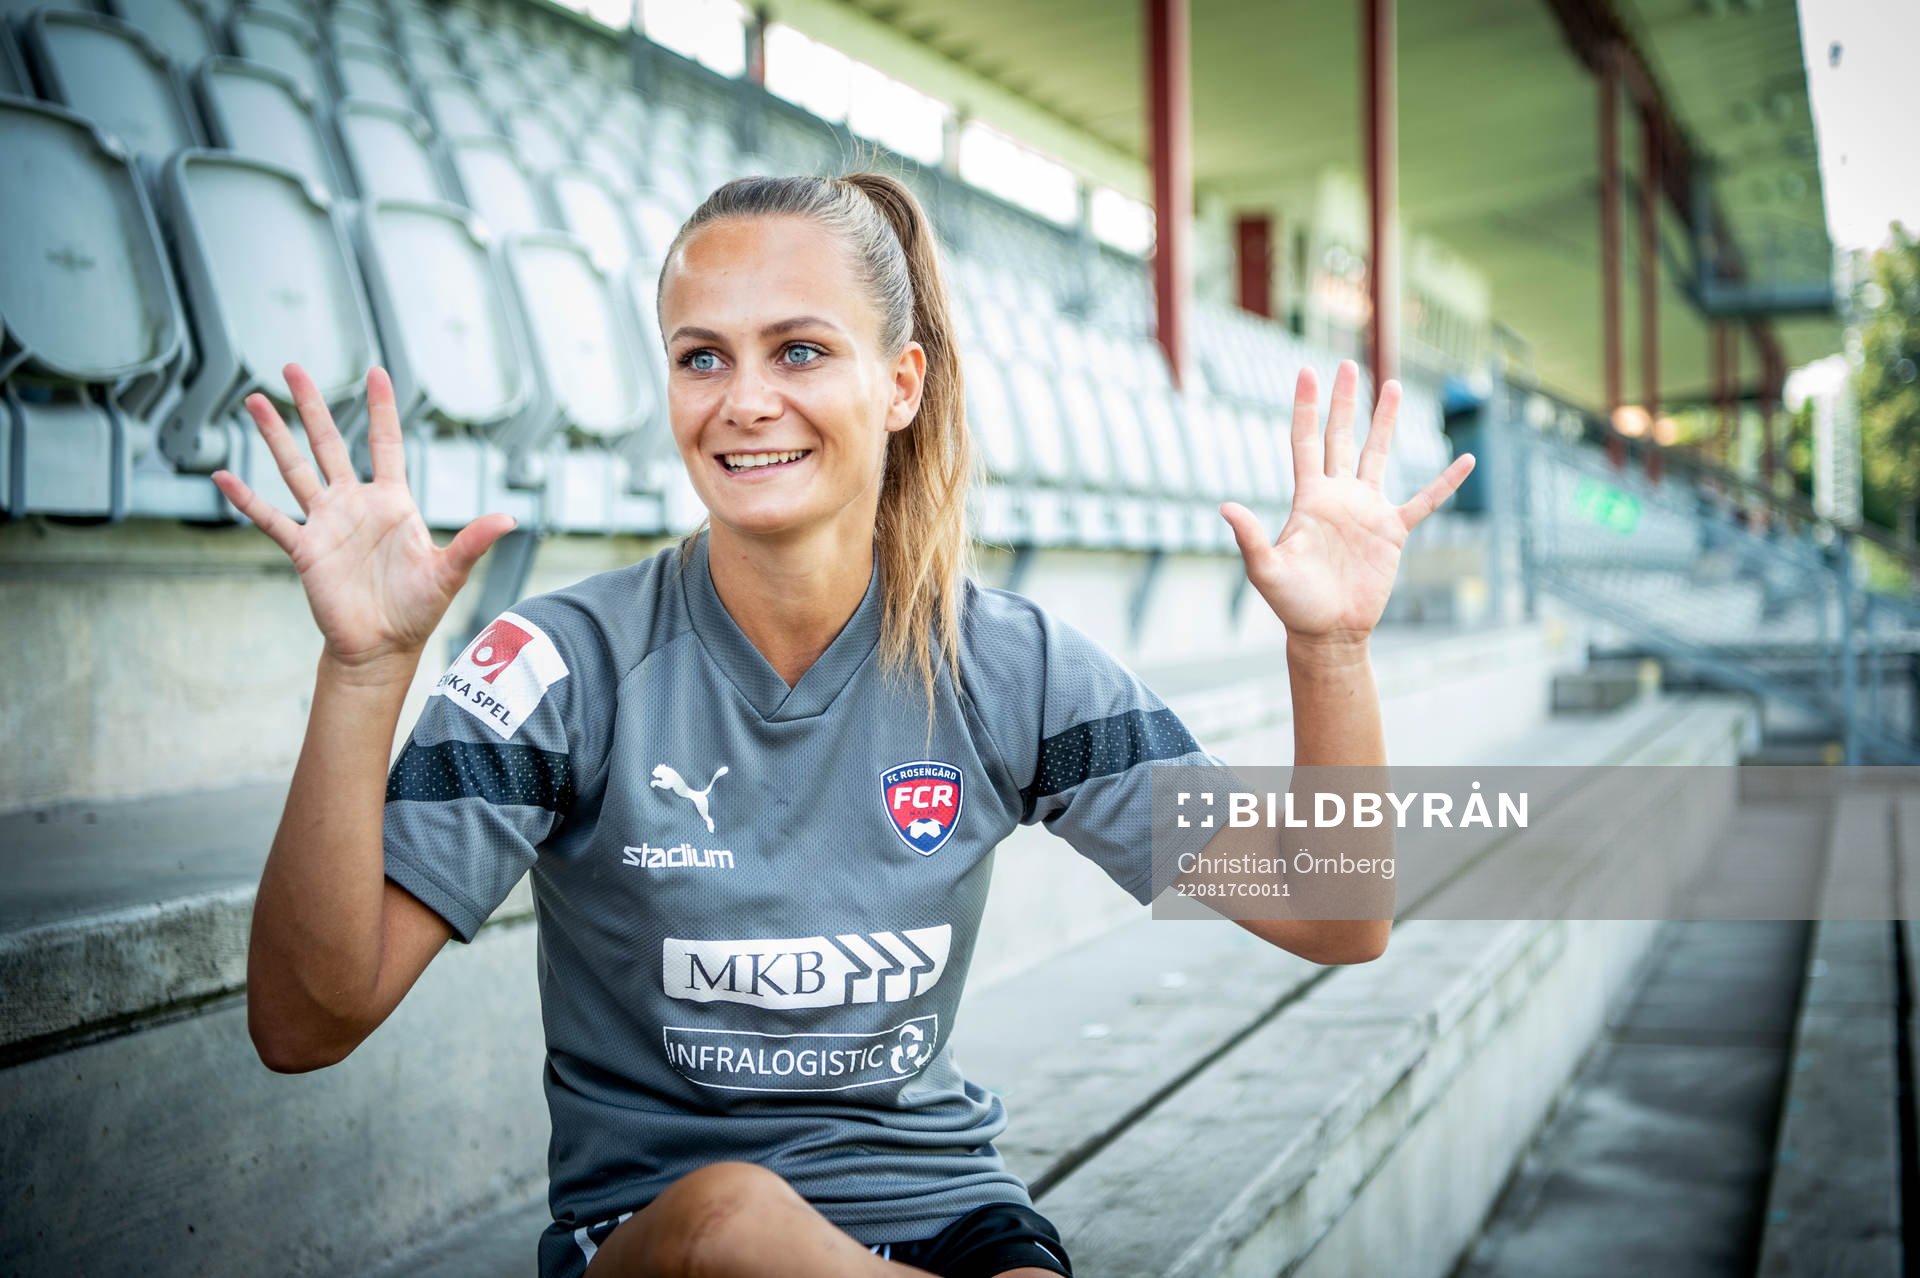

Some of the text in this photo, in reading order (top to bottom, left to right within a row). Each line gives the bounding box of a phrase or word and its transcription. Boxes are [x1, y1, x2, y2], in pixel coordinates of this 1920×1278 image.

[471, 690, 512, 726] SPEL
[886, 767, 957, 784] FC ROSENGÅRD
[893, 785, 953, 810] FCR
[622, 843, 735, 869] stadium
[685, 950, 826, 996] MKB
[669, 1042, 884, 1077] INFRALOGISTIC
